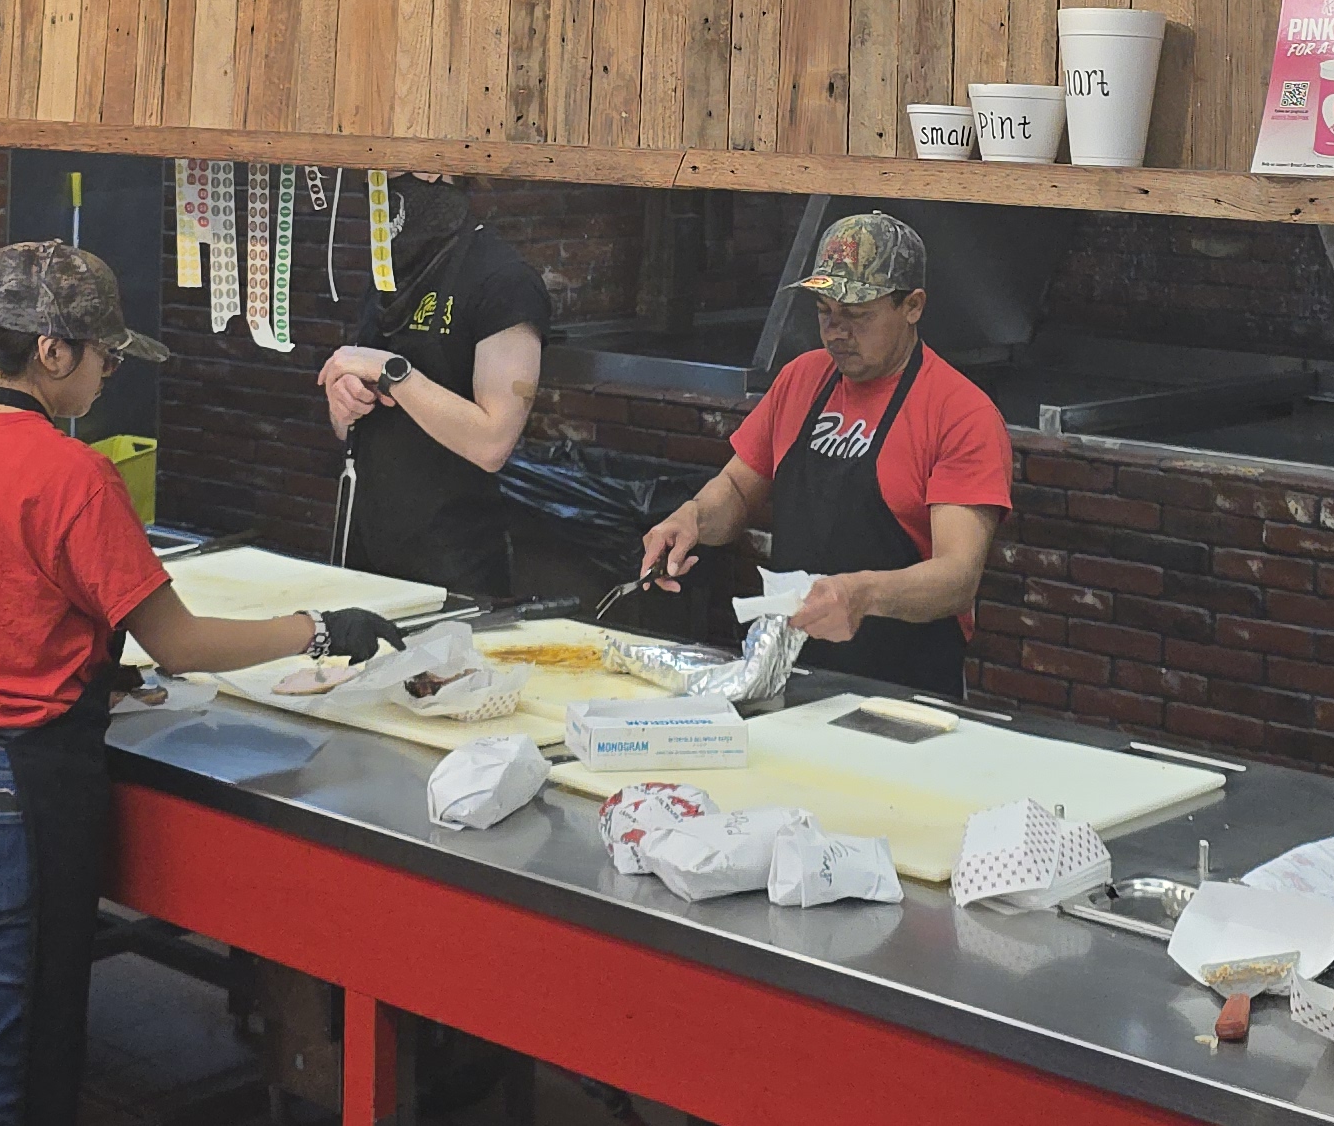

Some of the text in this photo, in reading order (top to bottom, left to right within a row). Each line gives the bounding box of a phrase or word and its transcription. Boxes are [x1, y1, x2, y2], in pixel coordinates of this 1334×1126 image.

[1287, 43, 1312, 57] FOR
[1317, 42, 1329, 54] A
[920, 126, 972, 146] small
[597, 741, 649, 752] MONOGRAM
